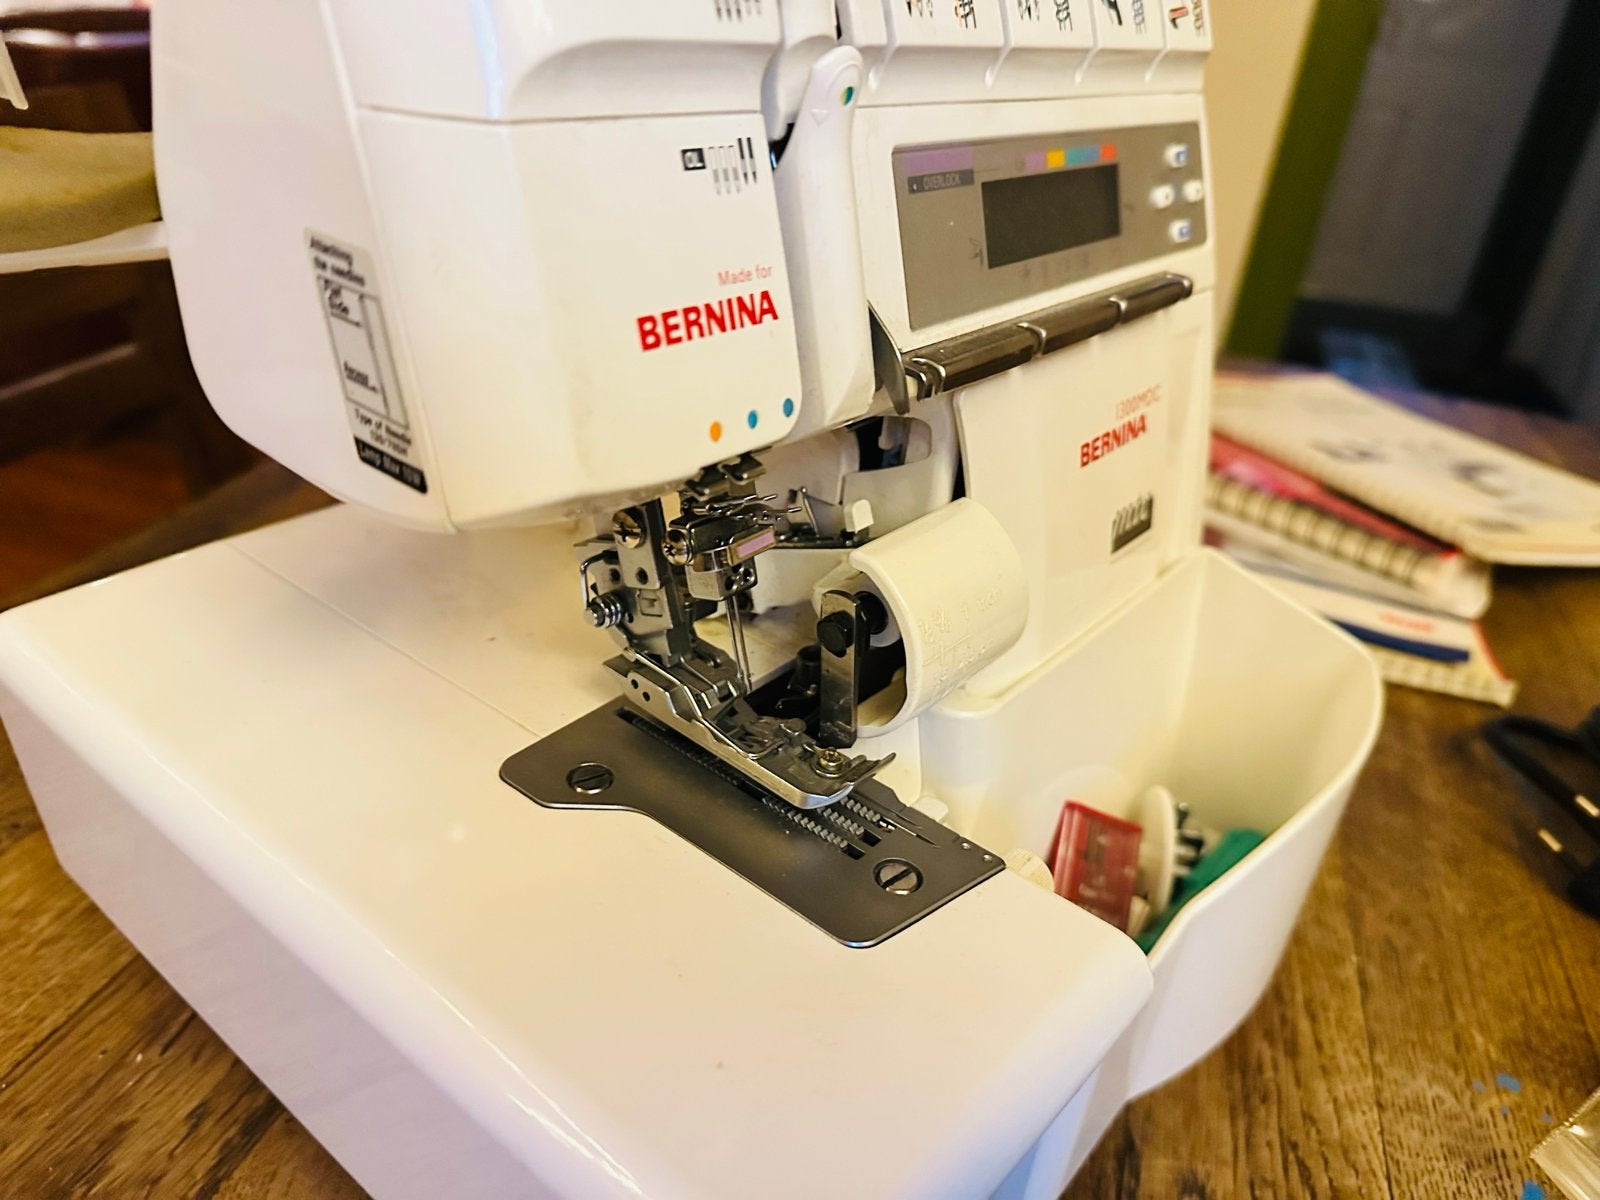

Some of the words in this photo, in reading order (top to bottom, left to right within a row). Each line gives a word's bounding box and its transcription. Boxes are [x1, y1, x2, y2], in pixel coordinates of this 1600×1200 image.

[717, 270, 752, 286] Made
[755, 264, 772, 279] for
[637, 290, 779, 352] BERNINA
[1080, 413, 1147, 468] BERNINA
